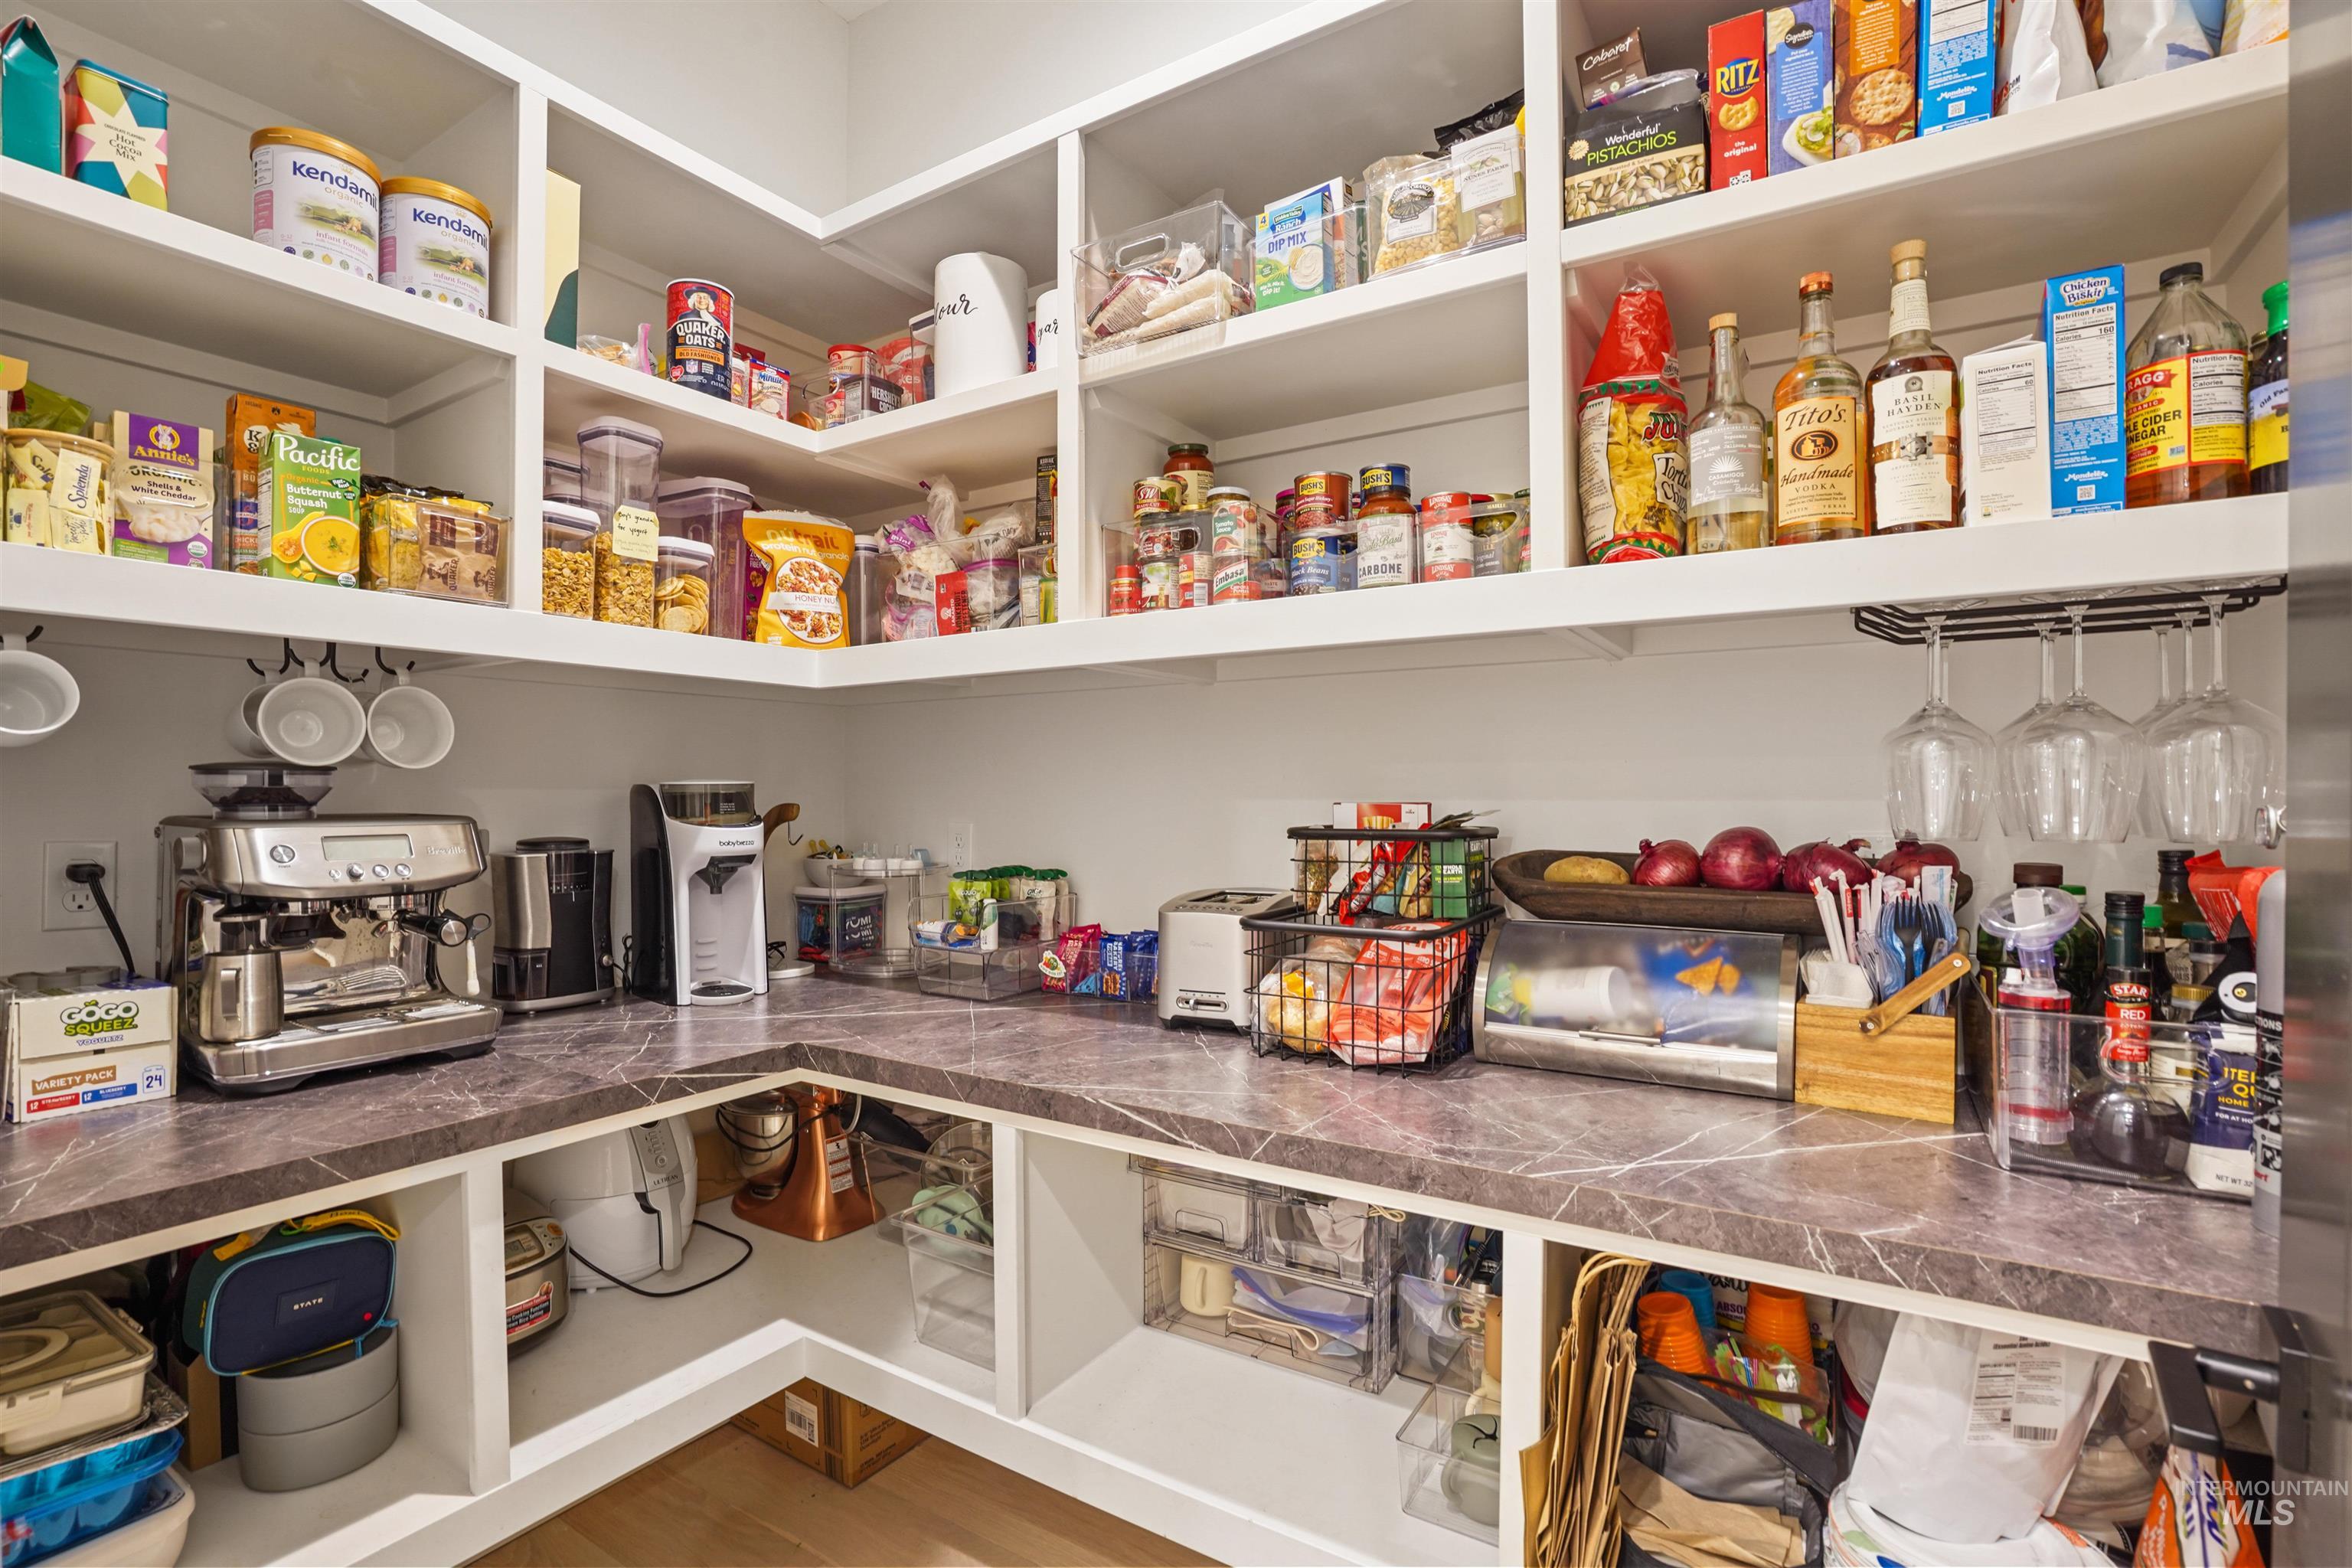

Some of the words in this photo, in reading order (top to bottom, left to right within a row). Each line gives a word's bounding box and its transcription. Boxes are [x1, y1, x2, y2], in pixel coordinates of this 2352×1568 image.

[1583, 36, 1633, 70] Cabaret
[1716, 58, 1760, 93] RITZ
[116, 133, 136, 146] Hot
[1605, 122, 1661, 145] Wonderful
[109, 139, 142, 156] Cocoa
[1587, 130, 1677, 166] PISTACHIOS
[1723, 143, 1757, 158] original
[116, 149, 136, 162] Mix
[292, 160, 378, 213] Kendamil
[324, 186, 364, 209] organic
[1260, 215, 1266, 224] 4
[1275, 218, 1302, 233] Ranch
[413, 207, 488, 251] Kendamil
[315, 230, 341, 243] infant
[341, 239, 368, 257] formula
[440, 230, 476, 249] organic
[1268, 238, 1285, 254] DIP
[1287, 231, 1306, 247] MIX
[433, 271, 456, 284] infant
[456, 277, 479, 293] formula
[2063, 279, 2108, 295] Chicken
[2066, 286, 2102, 304] Biskit
[2055, 310, 2090, 321] Nutrition
[2091, 305, 2115, 315] Facts
[676, 322, 725, 343] QUAKER
[2055, 333, 2082, 343] Calories
[2099, 325, 2115, 335] 160
[685, 335, 716, 348] OATS
[691, 352, 720, 362] FASHIONED
[2192, 354, 2227, 364] Nutrition
[1978, 366, 2011, 375] Nutrition
[2011, 361, 2033, 370] Facts
[2192, 380, 2224, 388] Calories
[1894, 393, 1935, 406] BASIL
[2259, 395, 2272, 408] Old
[1887, 403, 1943, 417] HAYDEN
[1785, 404, 1846, 431] Tito's
[2141, 409, 2182, 428] CIDER
[133, 446, 194, 466] Annie's
[273, 436, 361, 472] Pacific
[302, 465, 330, 475] FOODS
[1708, 472, 1745, 481] CASAMIGOS
[1780, 463, 1854, 488] Handmade
[68, 464, 90, 508] Splenda
[147, 480, 173, 491] Shells
[286, 473, 319, 485] Organic
[1361, 472, 1391, 487] BUSH'S
[131, 485, 159, 495] White
[161, 490, 197, 501] Cheddar
[286, 484, 342, 499] Butternut
[1300, 481, 1325, 493] BUSH'S
[1795, 483, 1836, 493] VODKA
[287, 496, 328, 509] Squash
[1429, 495, 1454, 505] LINDSAY
[629, 528, 648, 537] yogurt
[1215, 521, 1234, 530] Tomato
[1216, 526, 1231, 534] Sauce
[890, 534, 912, 546] mini
[1379, 532, 1404, 547] Basil
[761, 543, 801, 554] protein
[817, 551, 849, 560] granola
[449, 560, 459, 592] QUAKER
[1308, 564, 1330, 575] Beans
[1358, 563, 1403, 579] CARBONE
[1431, 564, 1455, 574] LINDSAY
[1215, 567, 1245, 588] Embasa
[795, 593, 822, 603] HONEY
[2113, 984, 2148, 998] STAR
[2120, 1008, 2146, 1021] RED
[76, 1034, 124, 1047] YOGURTZ
[35, 1076, 81, 1089] VARIETY
[85, 1070, 113, 1083] PACK
[145, 1075, 162, 1089] 24
[83, 1093, 92, 1101] 12
[2217, 1096, 2249, 1108] HOME
[30, 1102, 39, 1110] 12
[2215, 1112, 2230, 1120] FOR
[652, 1175, 681, 1188] ULTREAN
[2215, 1173, 2230, 1183] NET
[2230, 1177, 2242, 1185] WT
[293, 1296, 324, 1311] STATE
[512, 1310, 530, 1322] Cooking
[531, 1301, 550, 1313] Functions
[519, 1316, 529, 1325] Rice
[530, 1311, 544, 1321] Setting
